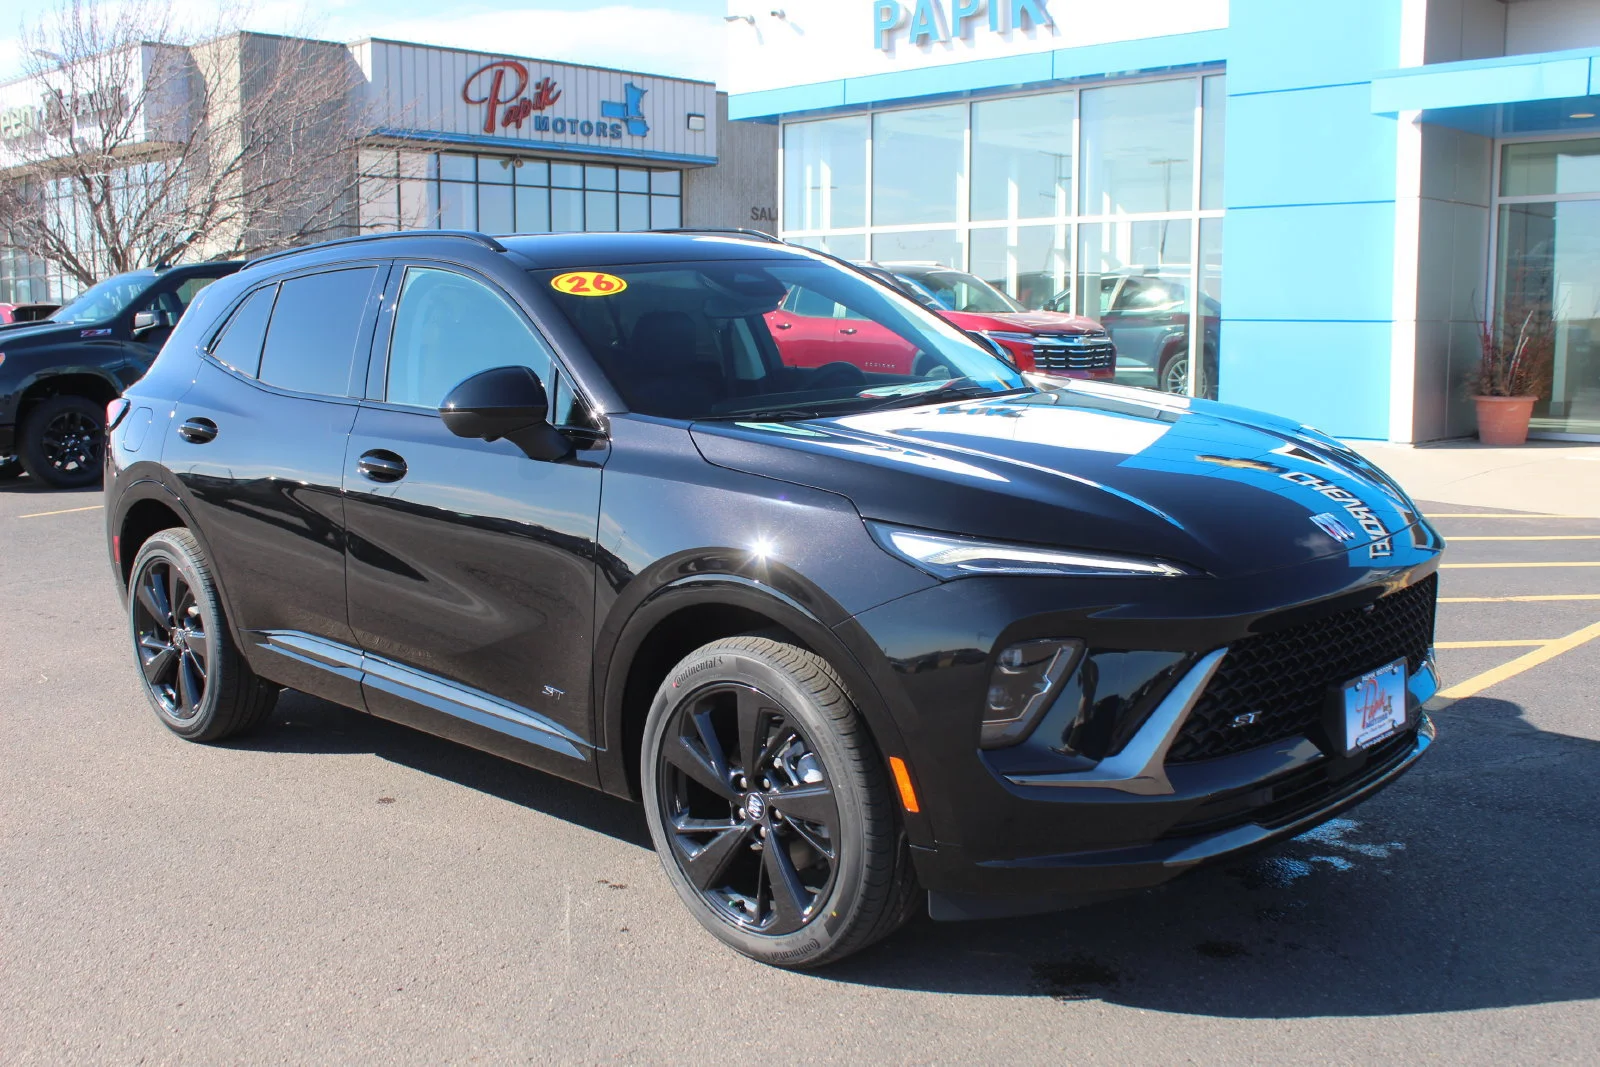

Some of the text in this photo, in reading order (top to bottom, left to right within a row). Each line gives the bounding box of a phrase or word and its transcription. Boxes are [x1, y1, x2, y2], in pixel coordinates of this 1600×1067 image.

[462, 60, 562, 134] Papik
[534, 115, 623, 139] MOTORS
[751, 206, 779, 221] SAL
[566, 274, 614, 293] 26
